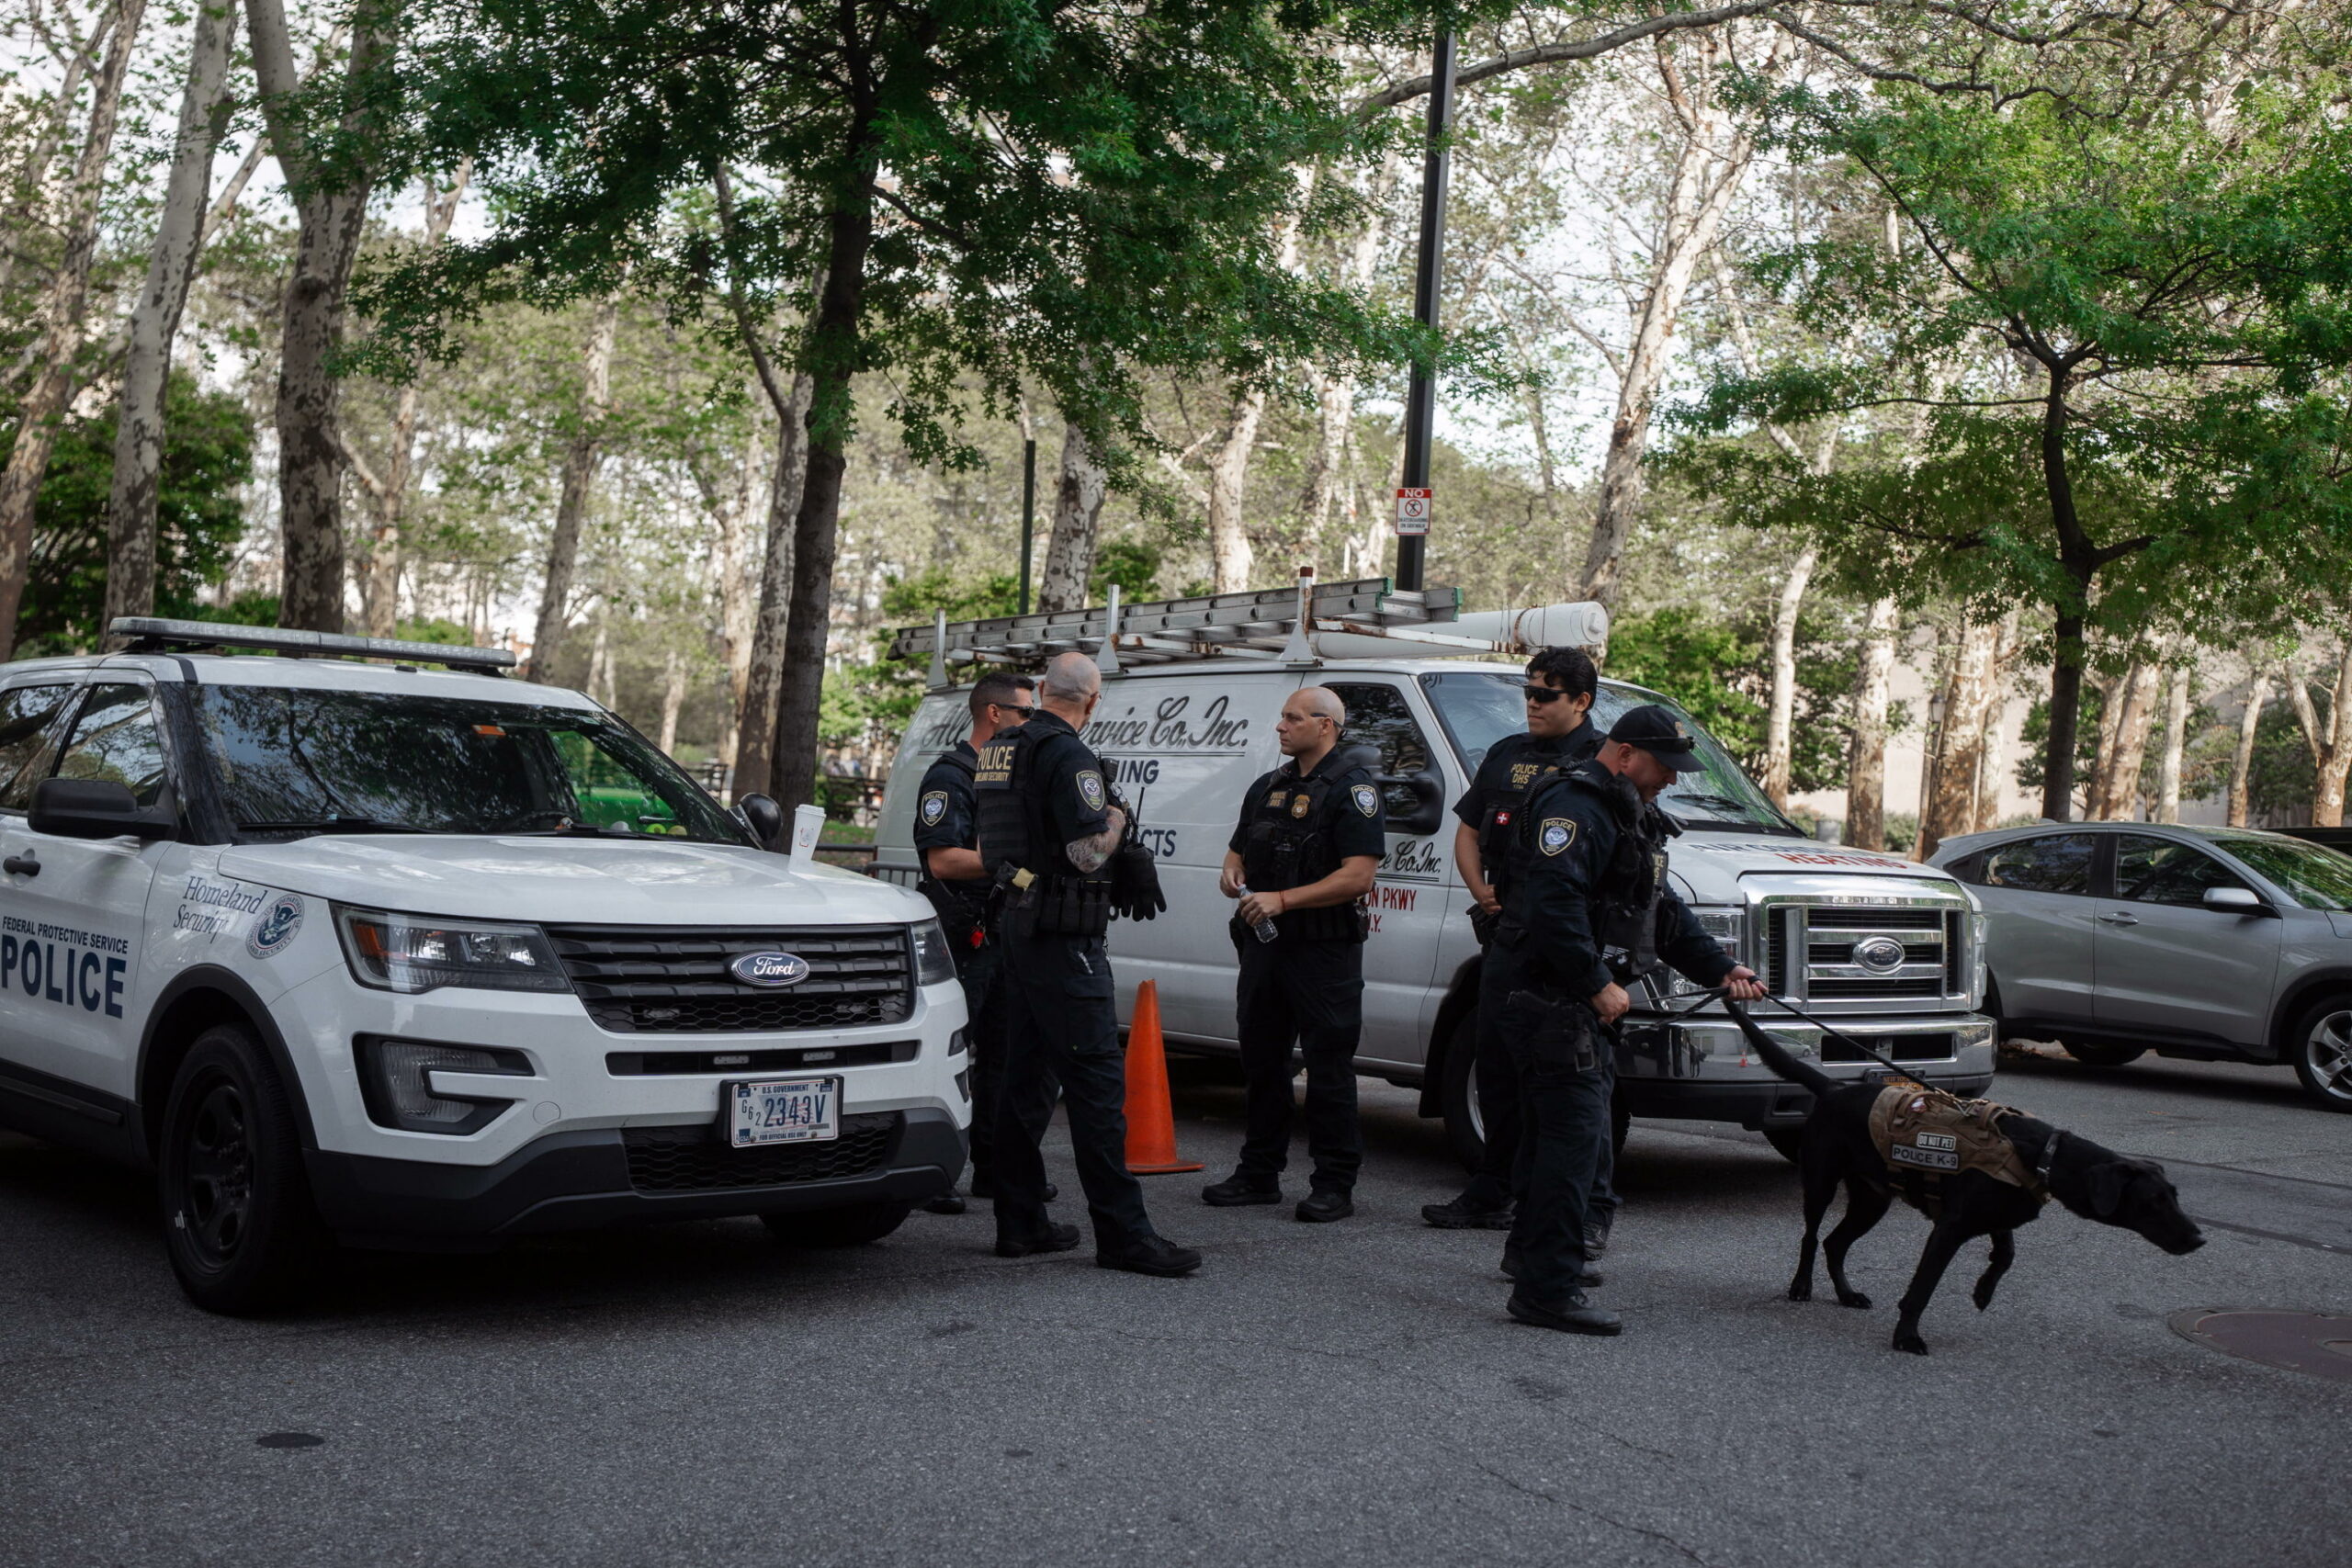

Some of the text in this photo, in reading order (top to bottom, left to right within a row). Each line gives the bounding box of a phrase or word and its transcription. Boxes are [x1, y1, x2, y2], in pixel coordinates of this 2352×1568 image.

[1405, 490, 1424, 498] NO
[1079, 706, 1148, 746] ervice
[977, 746, 1014, 771] POLICE
[1118, 760, 1159, 784] ING
[1510, 763, 1539, 775] POLICE
[1511, 773, 1530, 784] DHS
[1545, 820, 1573, 830] POLICE
[1774, 853, 1908, 869] HEATING
[183, 876, 267, 915] Homeland
[1383, 887, 1417, 911] PKWY
[173, 905, 229, 944] Security
[2, 916, 129, 954] FEDERAL PROTECTIVE SERVICE
[258, 936, 291, 956] SECURITY
[753, 956, 795, 976] Ford
[1, 934, 127, 1020] POLICE
[762, 1084, 808, 1094] U.S. GOVERNMENT
[763, 1095, 826, 1127] 2343V
[1928, 1136, 1940, 1146] NOT
[1941, 1137, 1954, 1148] PET
[1894, 1147, 1957, 1167] POLICE K-9
